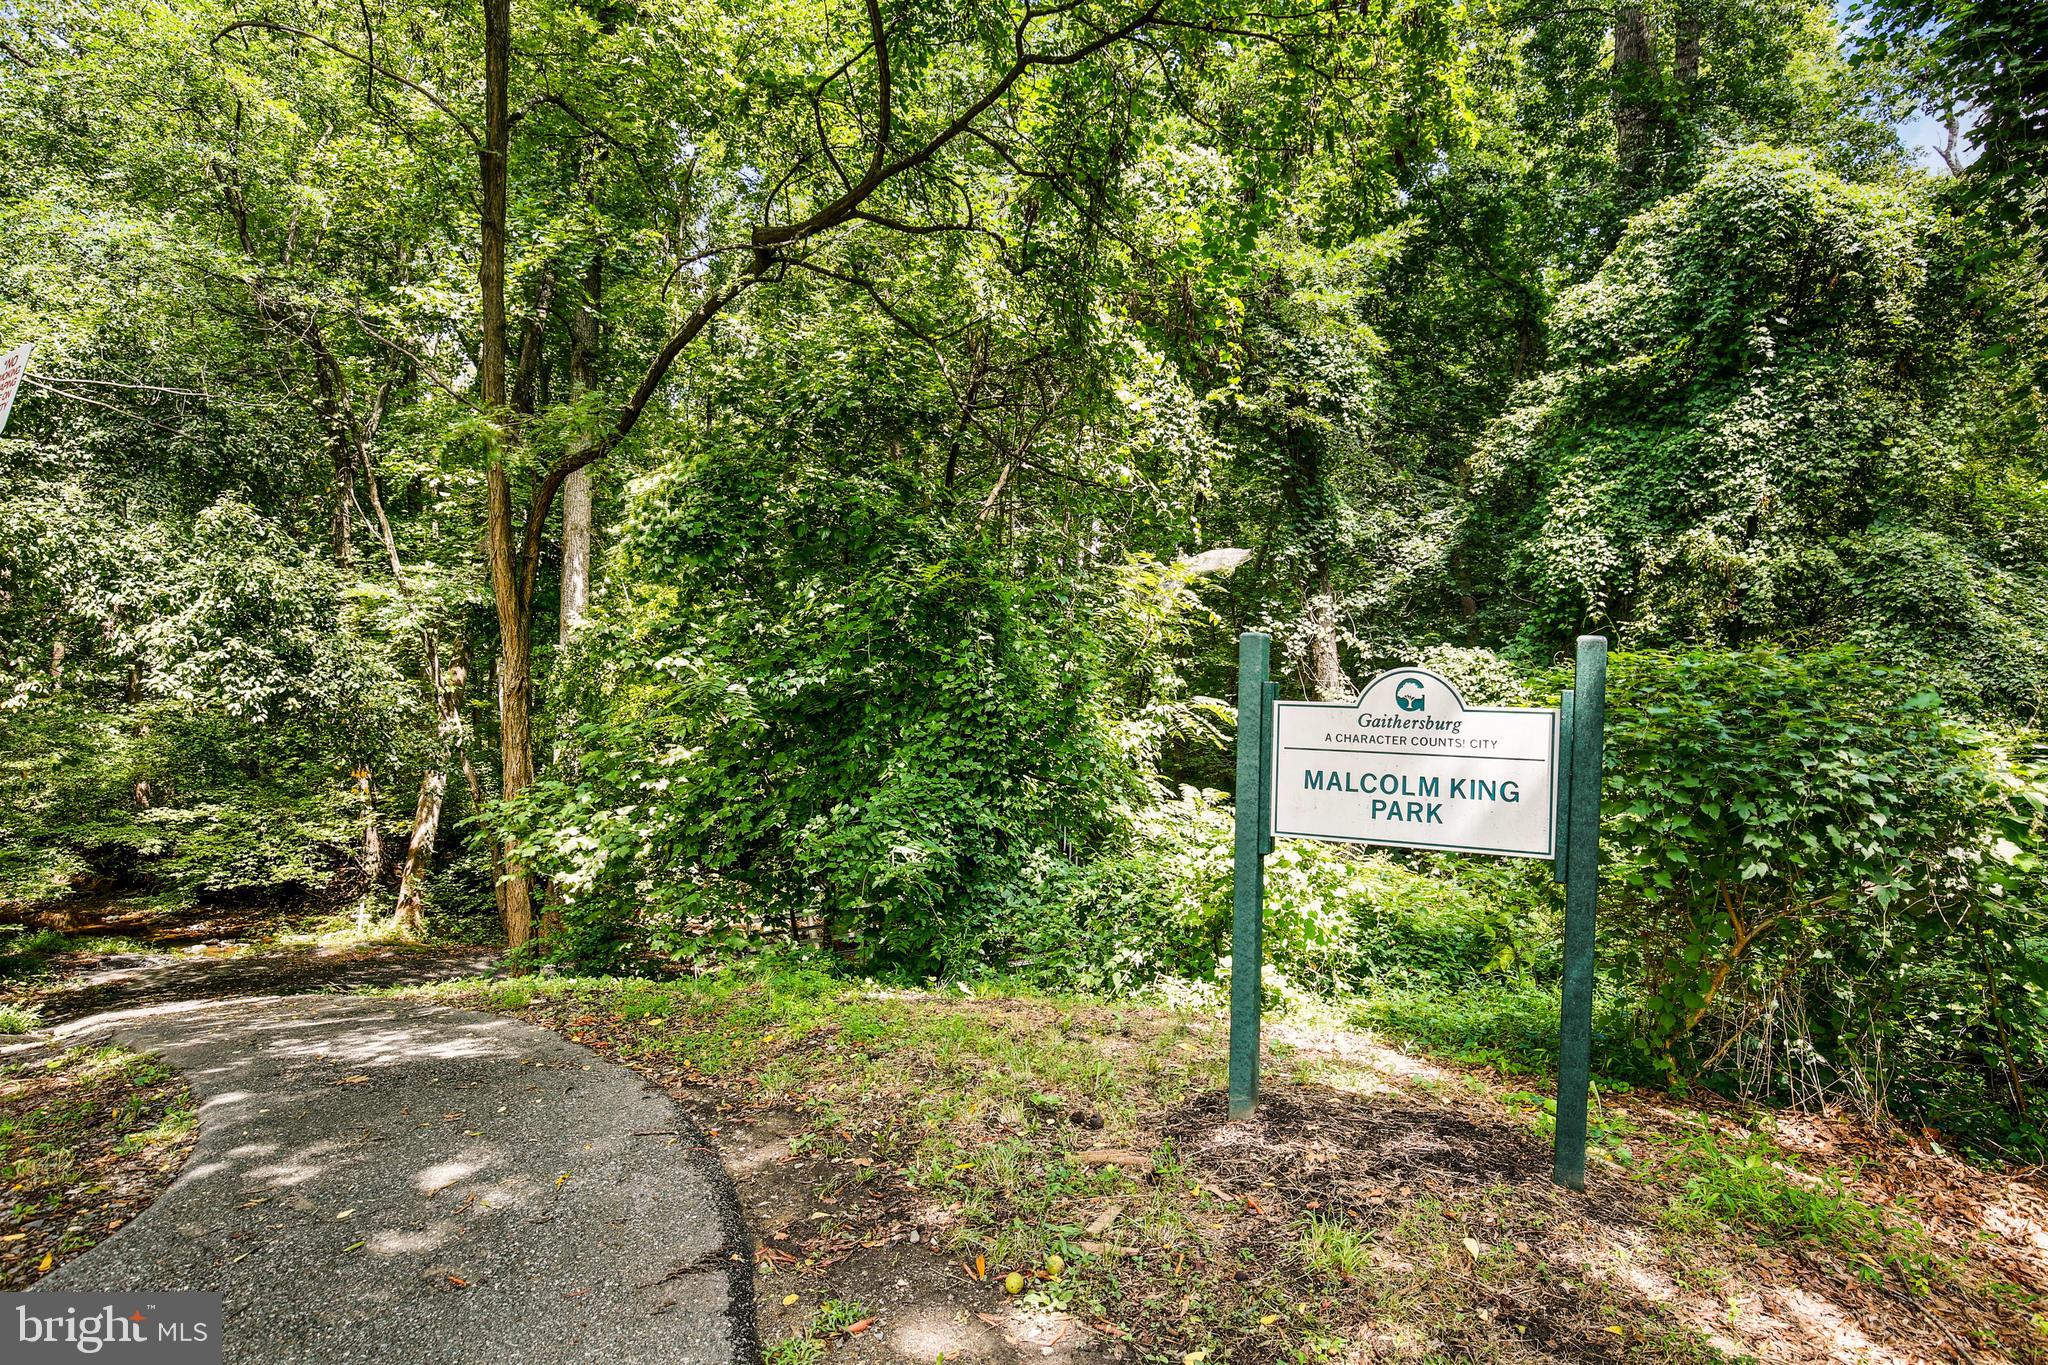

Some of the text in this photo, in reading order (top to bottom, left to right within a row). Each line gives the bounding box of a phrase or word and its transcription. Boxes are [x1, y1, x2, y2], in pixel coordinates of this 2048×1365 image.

[1358, 713, 1462, 733] Gaithersburg
[1325, 733, 1498, 749] A CHARACTER COUNTS! CITY
[1304, 769, 1520, 803] MALCOLM KING
[1371, 799, 1443, 824] PARK
